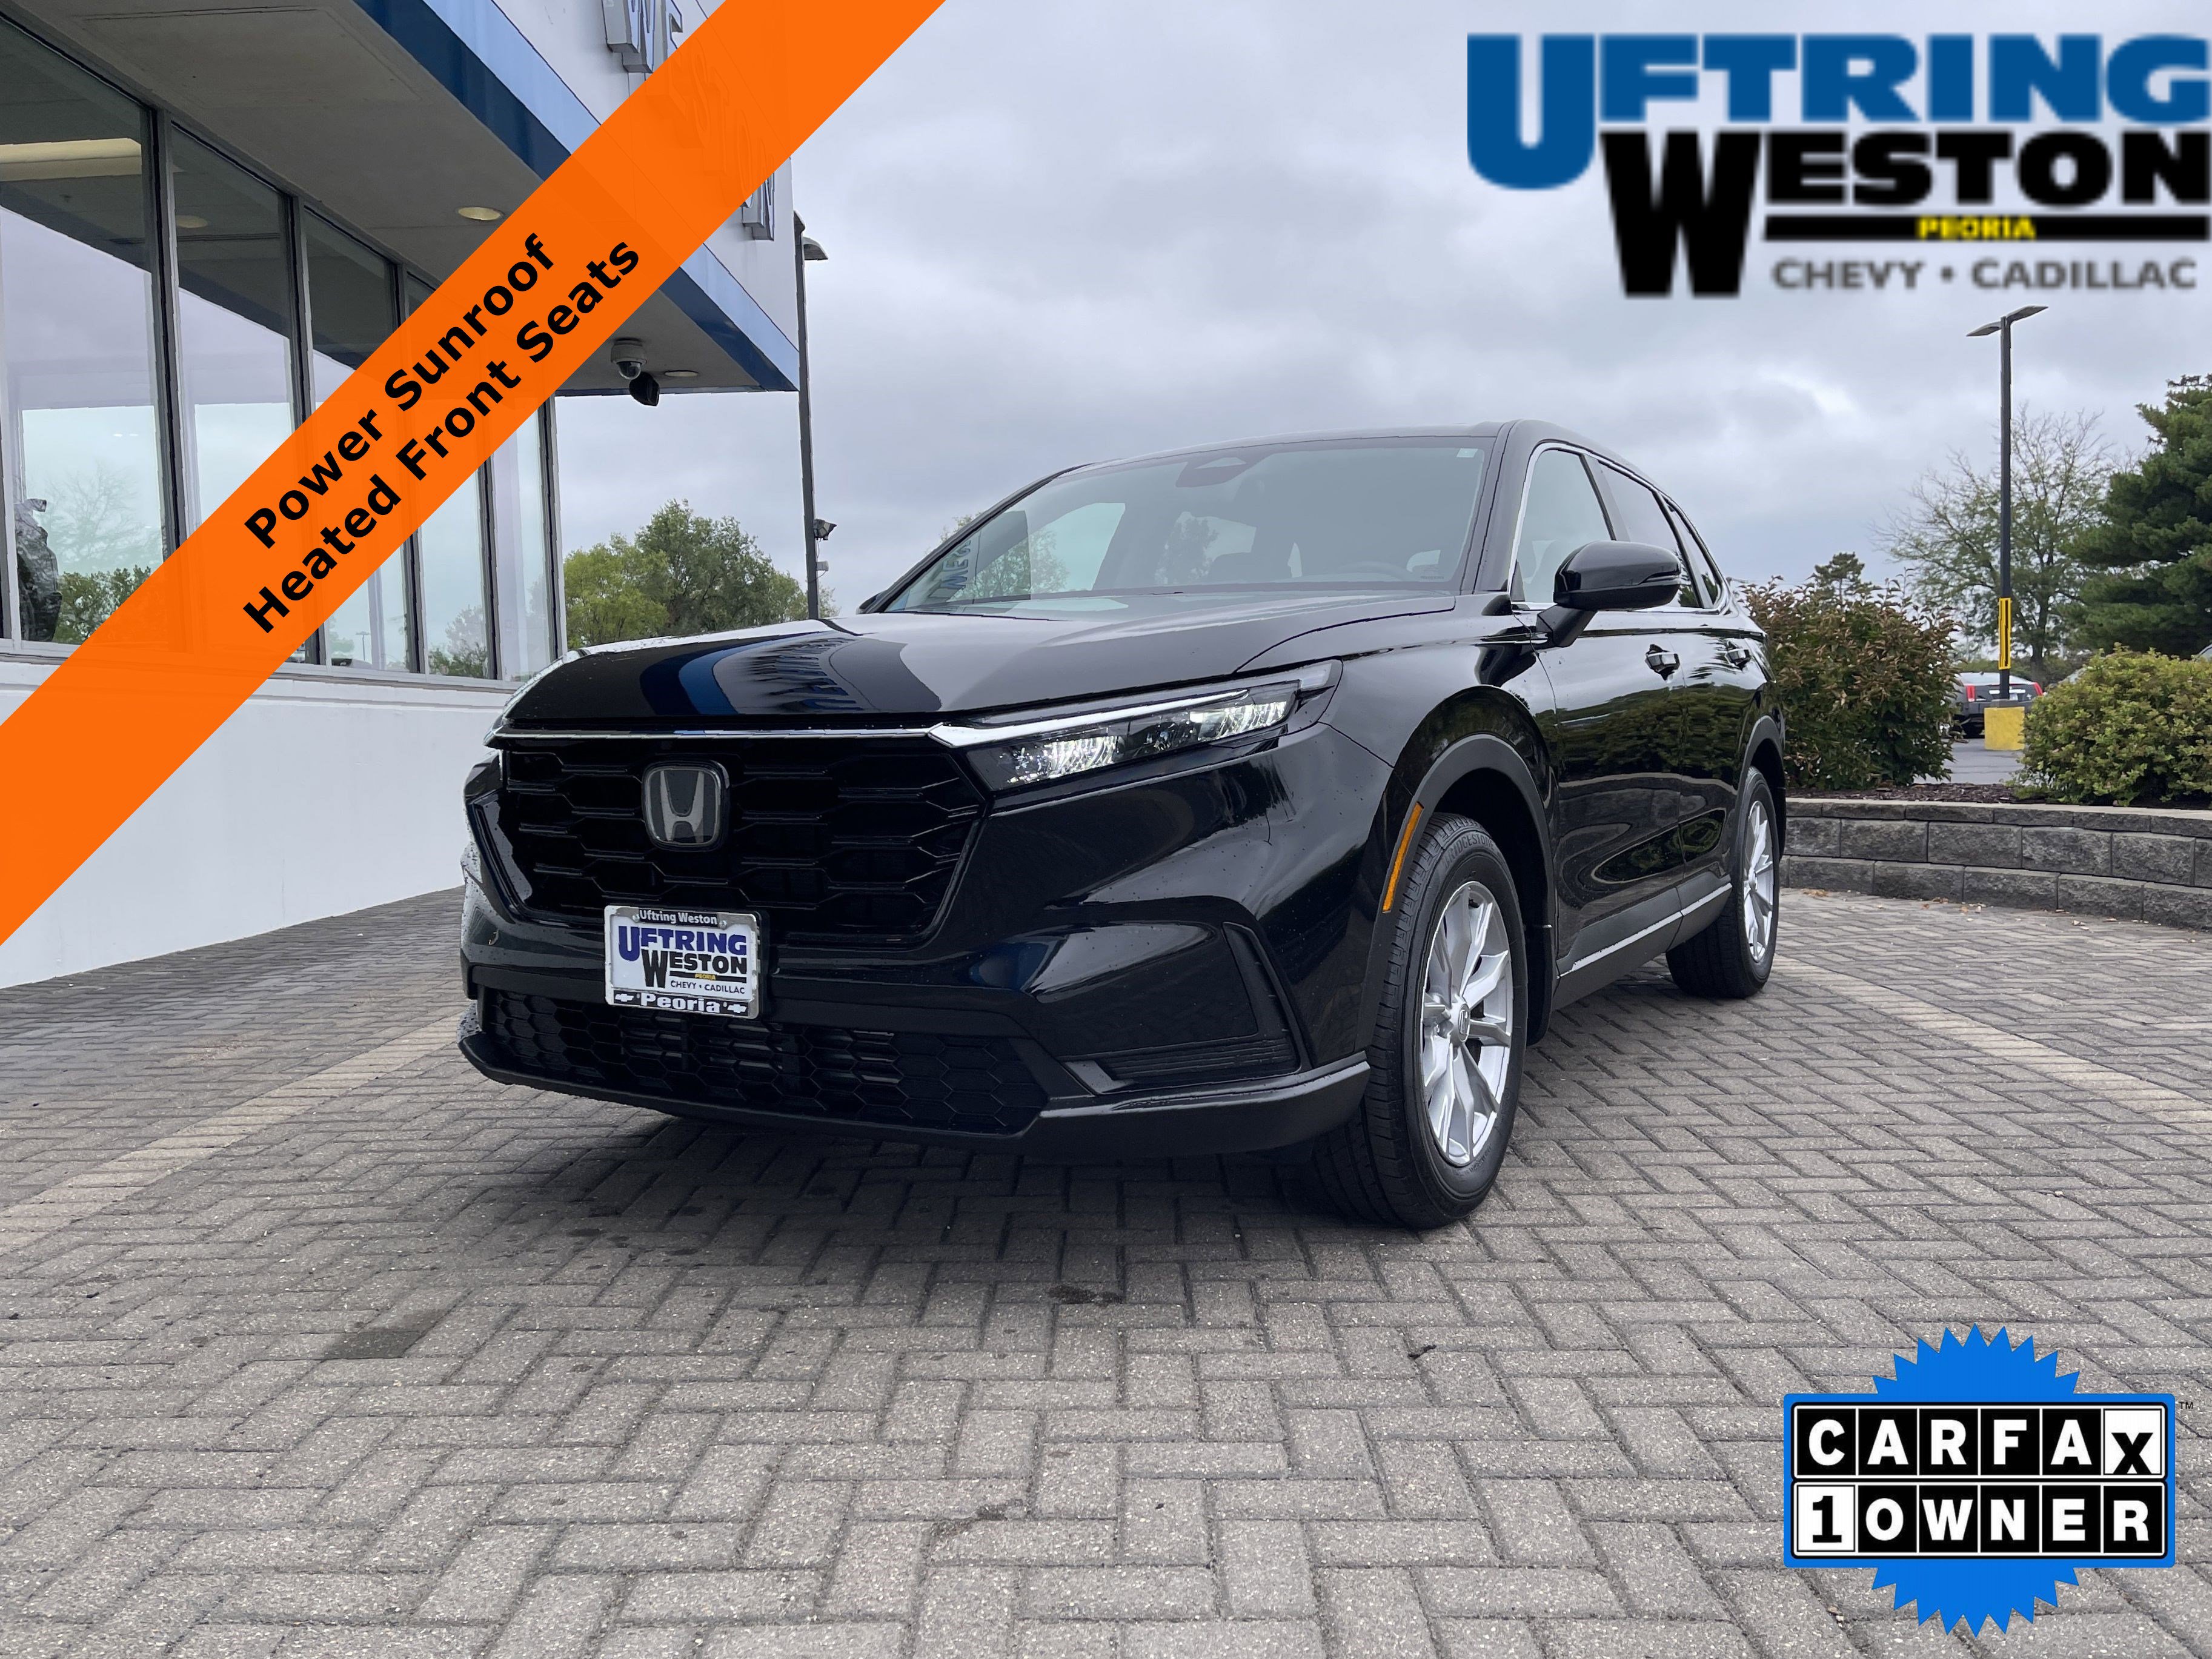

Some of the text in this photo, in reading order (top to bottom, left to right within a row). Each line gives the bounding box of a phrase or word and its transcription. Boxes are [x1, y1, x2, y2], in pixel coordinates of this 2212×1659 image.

[640, 909, 717, 925] Uftring Weston
[619, 926, 747, 961] UFTRING
[642, 949, 747, 988] WESTON
[671, 980, 745, 994] CHEVY CADILLAC
[641, 992, 720, 1013] Peoria
